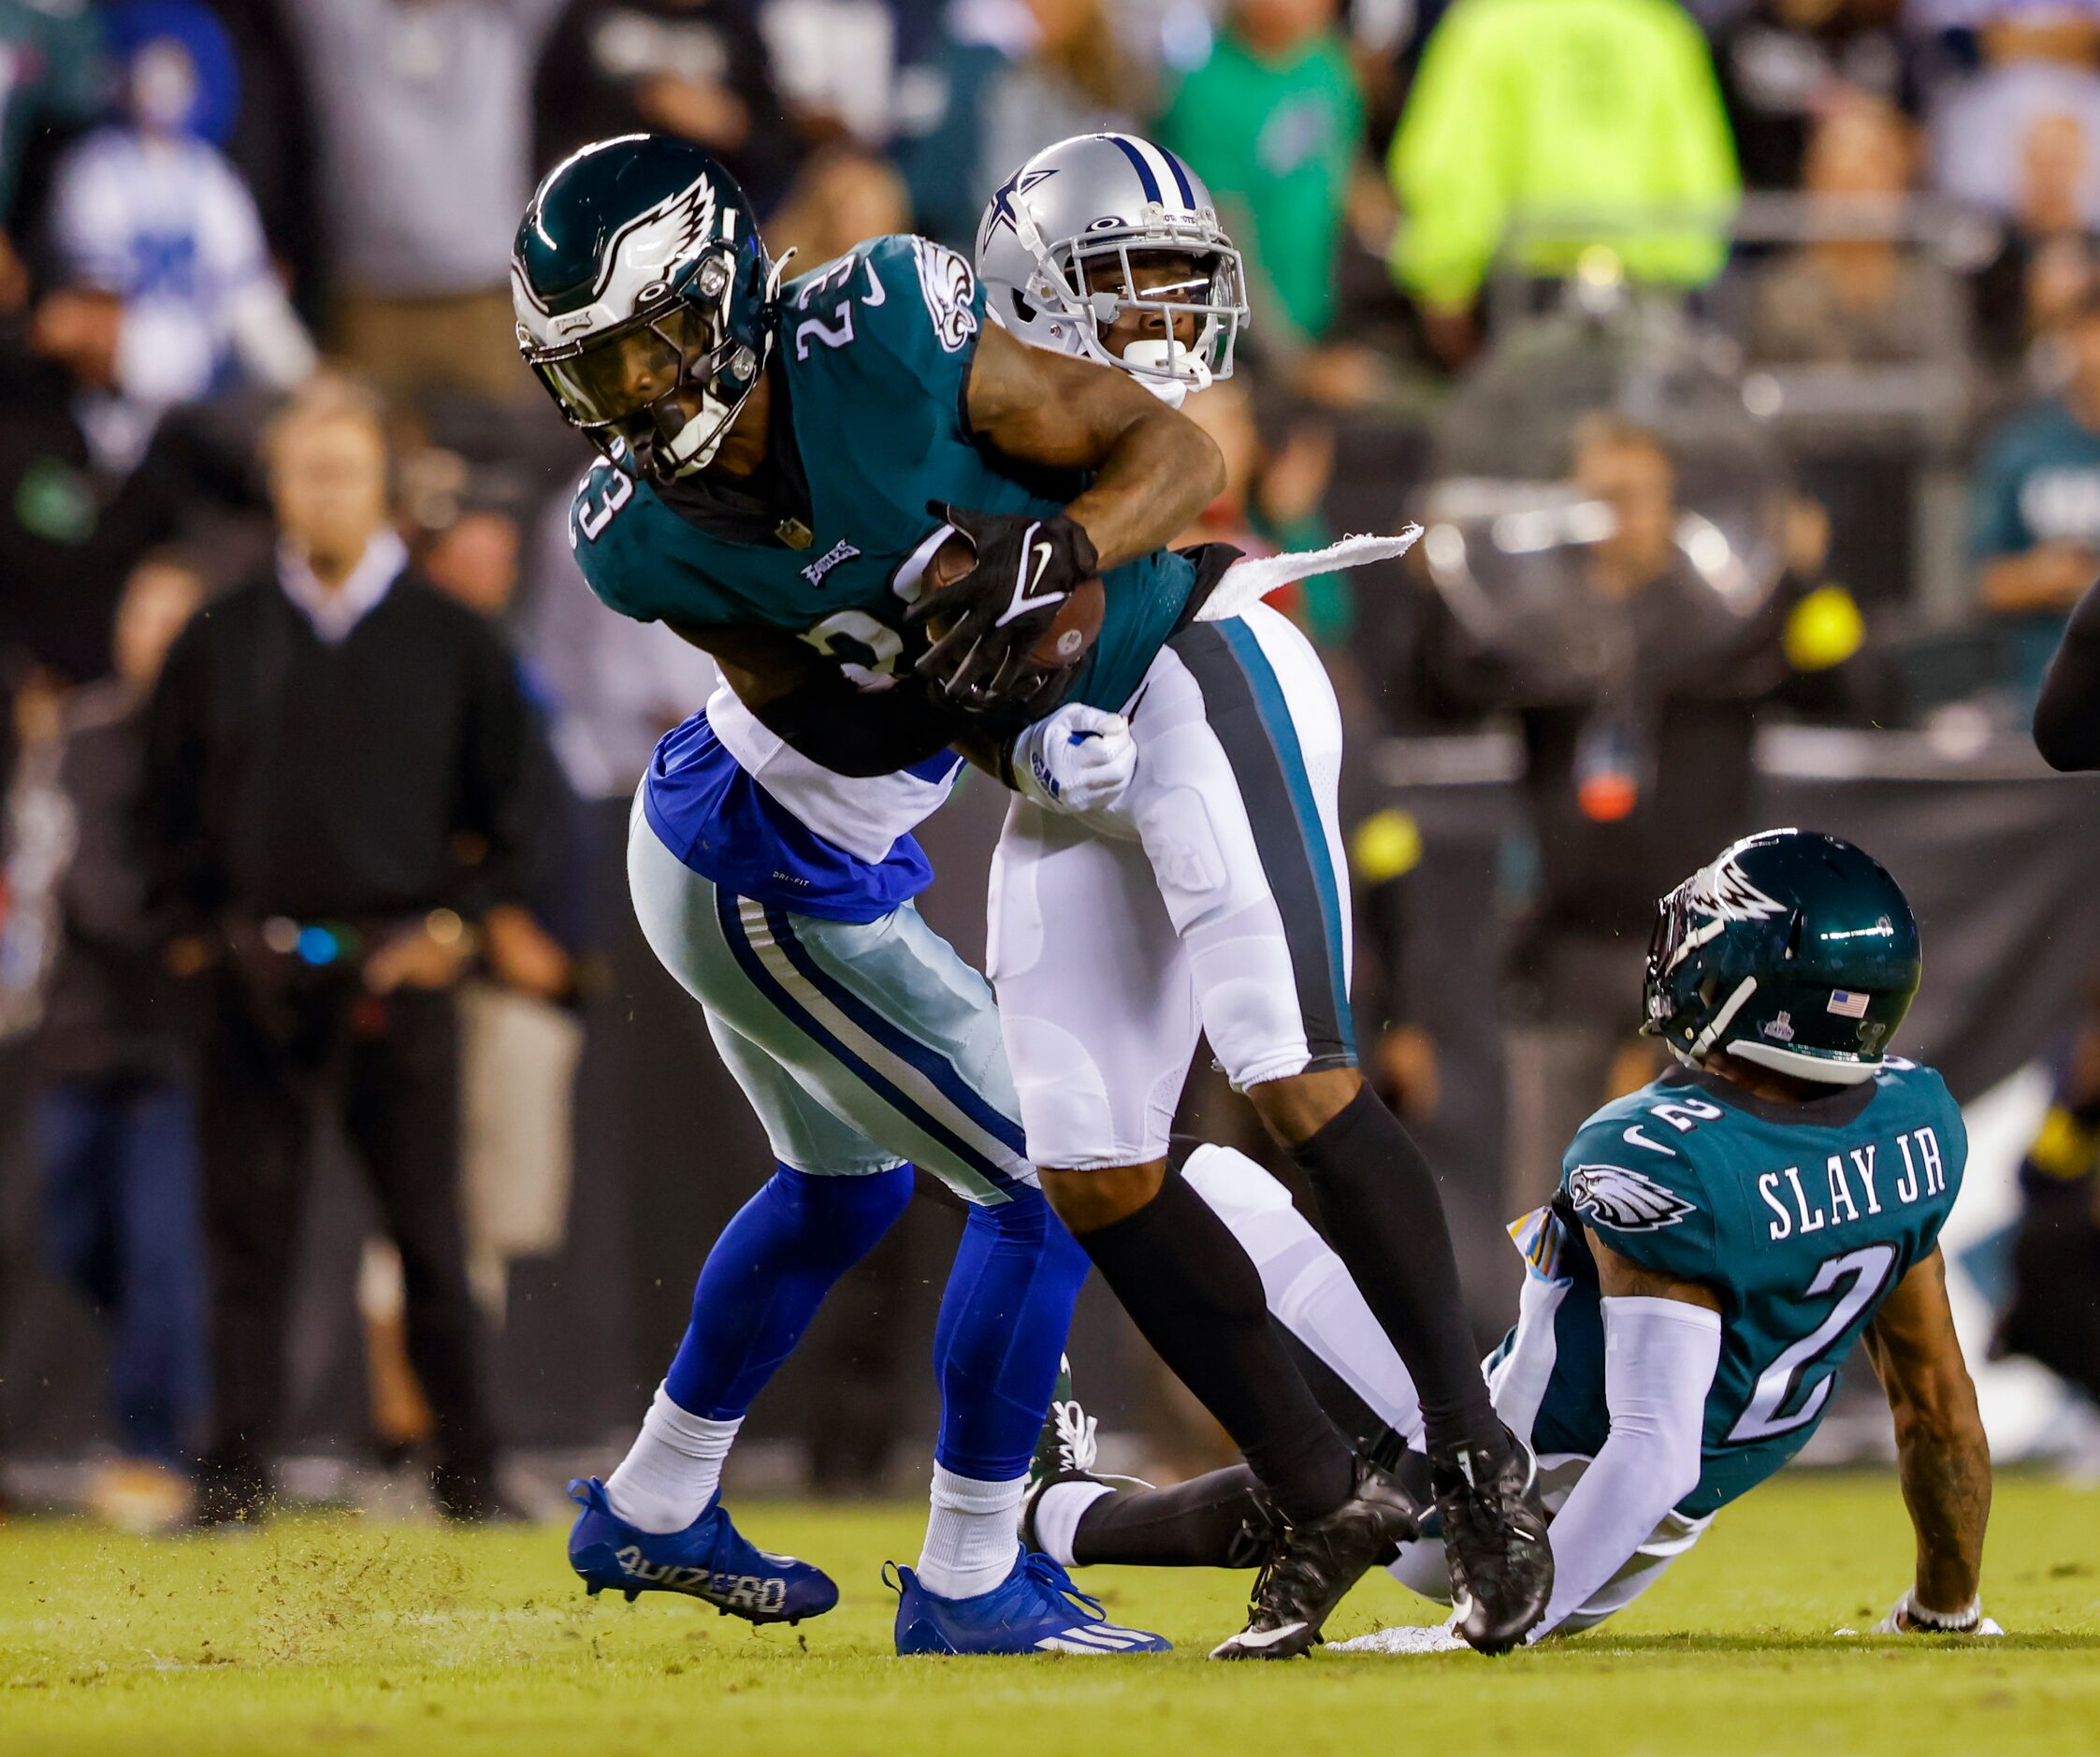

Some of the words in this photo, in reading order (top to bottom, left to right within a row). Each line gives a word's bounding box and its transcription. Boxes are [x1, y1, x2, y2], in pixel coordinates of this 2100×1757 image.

[795, 253, 857, 362] 23
[773, 870, 810, 886] DRI-FIT
[1649, 1097, 1724, 1135] 2
[1759, 1144, 1882, 1242] SLAY
[1895, 1126, 1947, 1205] JR
[1725, 1242, 1897, 1443] 2
